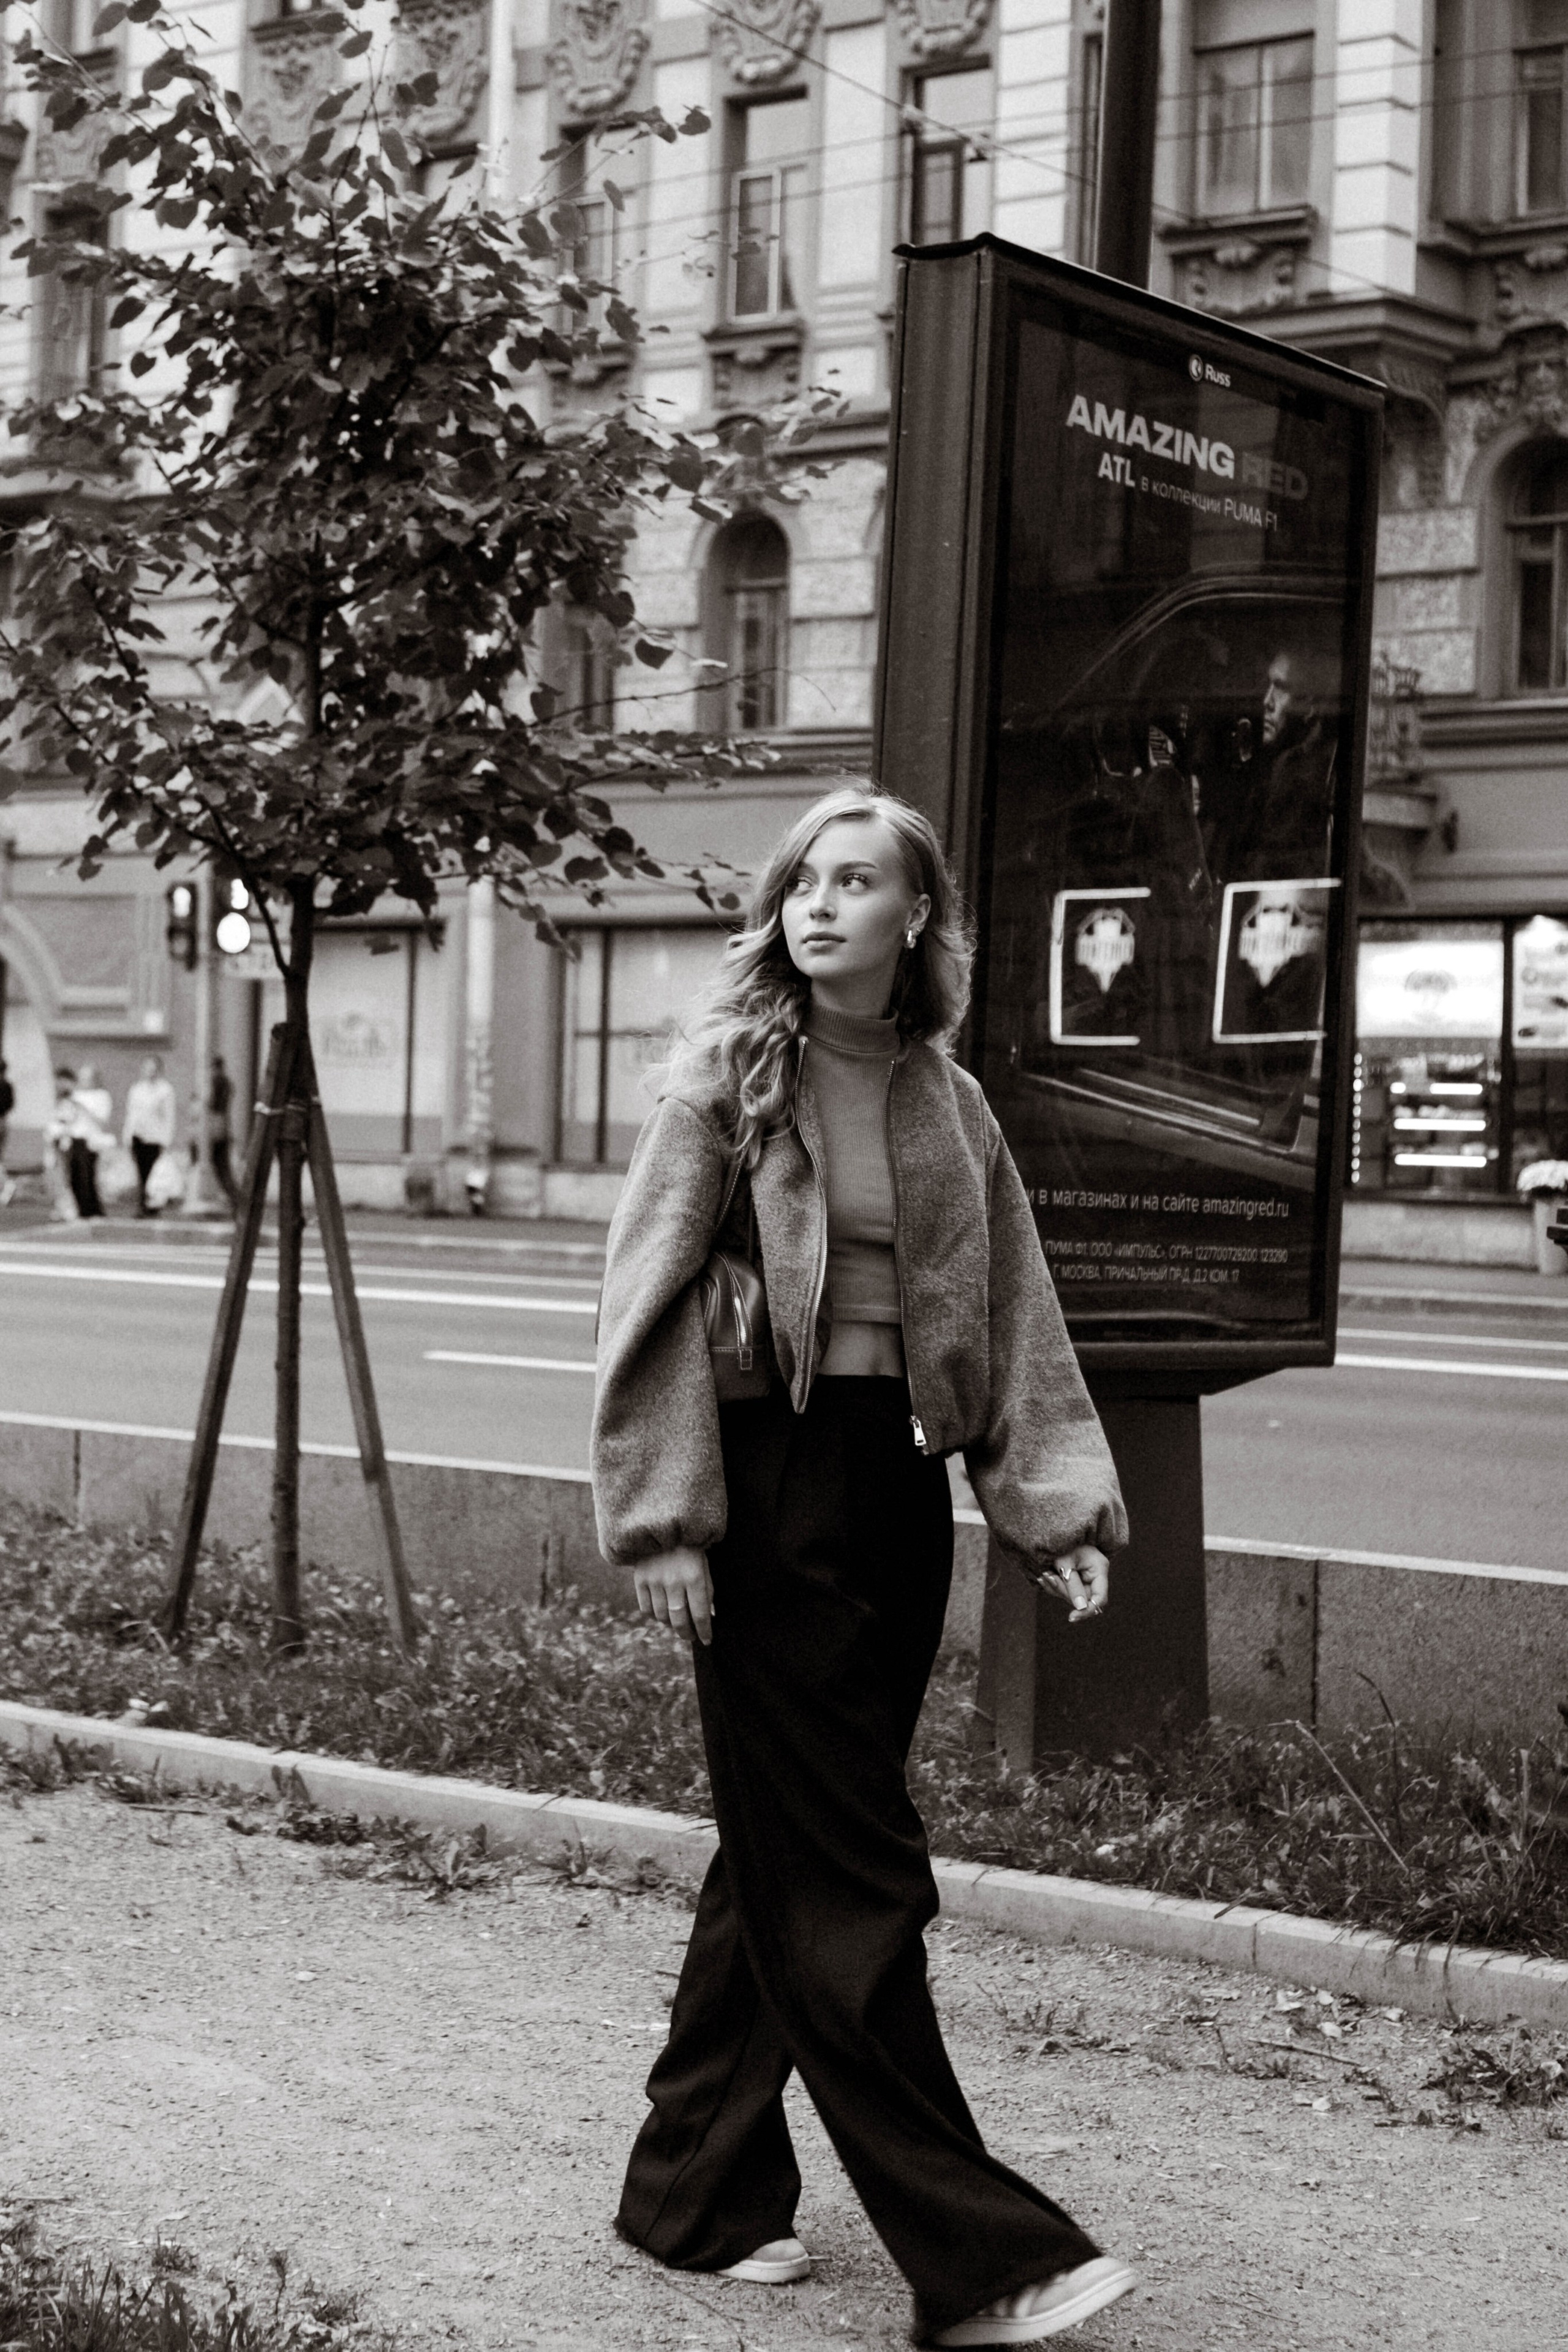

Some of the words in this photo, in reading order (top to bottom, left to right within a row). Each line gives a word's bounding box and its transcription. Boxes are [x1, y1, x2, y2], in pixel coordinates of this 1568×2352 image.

[1205, 363, 1231, 388] Russ
[1066, 394, 1235, 480] AMAZING
[1242, 451, 1308, 500] RED
[1098, 452, 1136, 488] ATL
[1152, 480, 1221, 514] коллекции
[1224, 497, 1262, 528] PUMA
[1265, 510, 1278, 532] F1
[1053, 1189, 1127, 1209] магазинах
[1131, 1194, 1139, 1210] и
[1143, 1194, 1159, 1211] на
[1163, 1193, 1200, 1213] сайте
[1203, 1196, 1289, 1221] amazingred.ru
[1045, 1240, 1072, 1256] ПУМА
[1091, 1242, 1113, 1257] ООО
